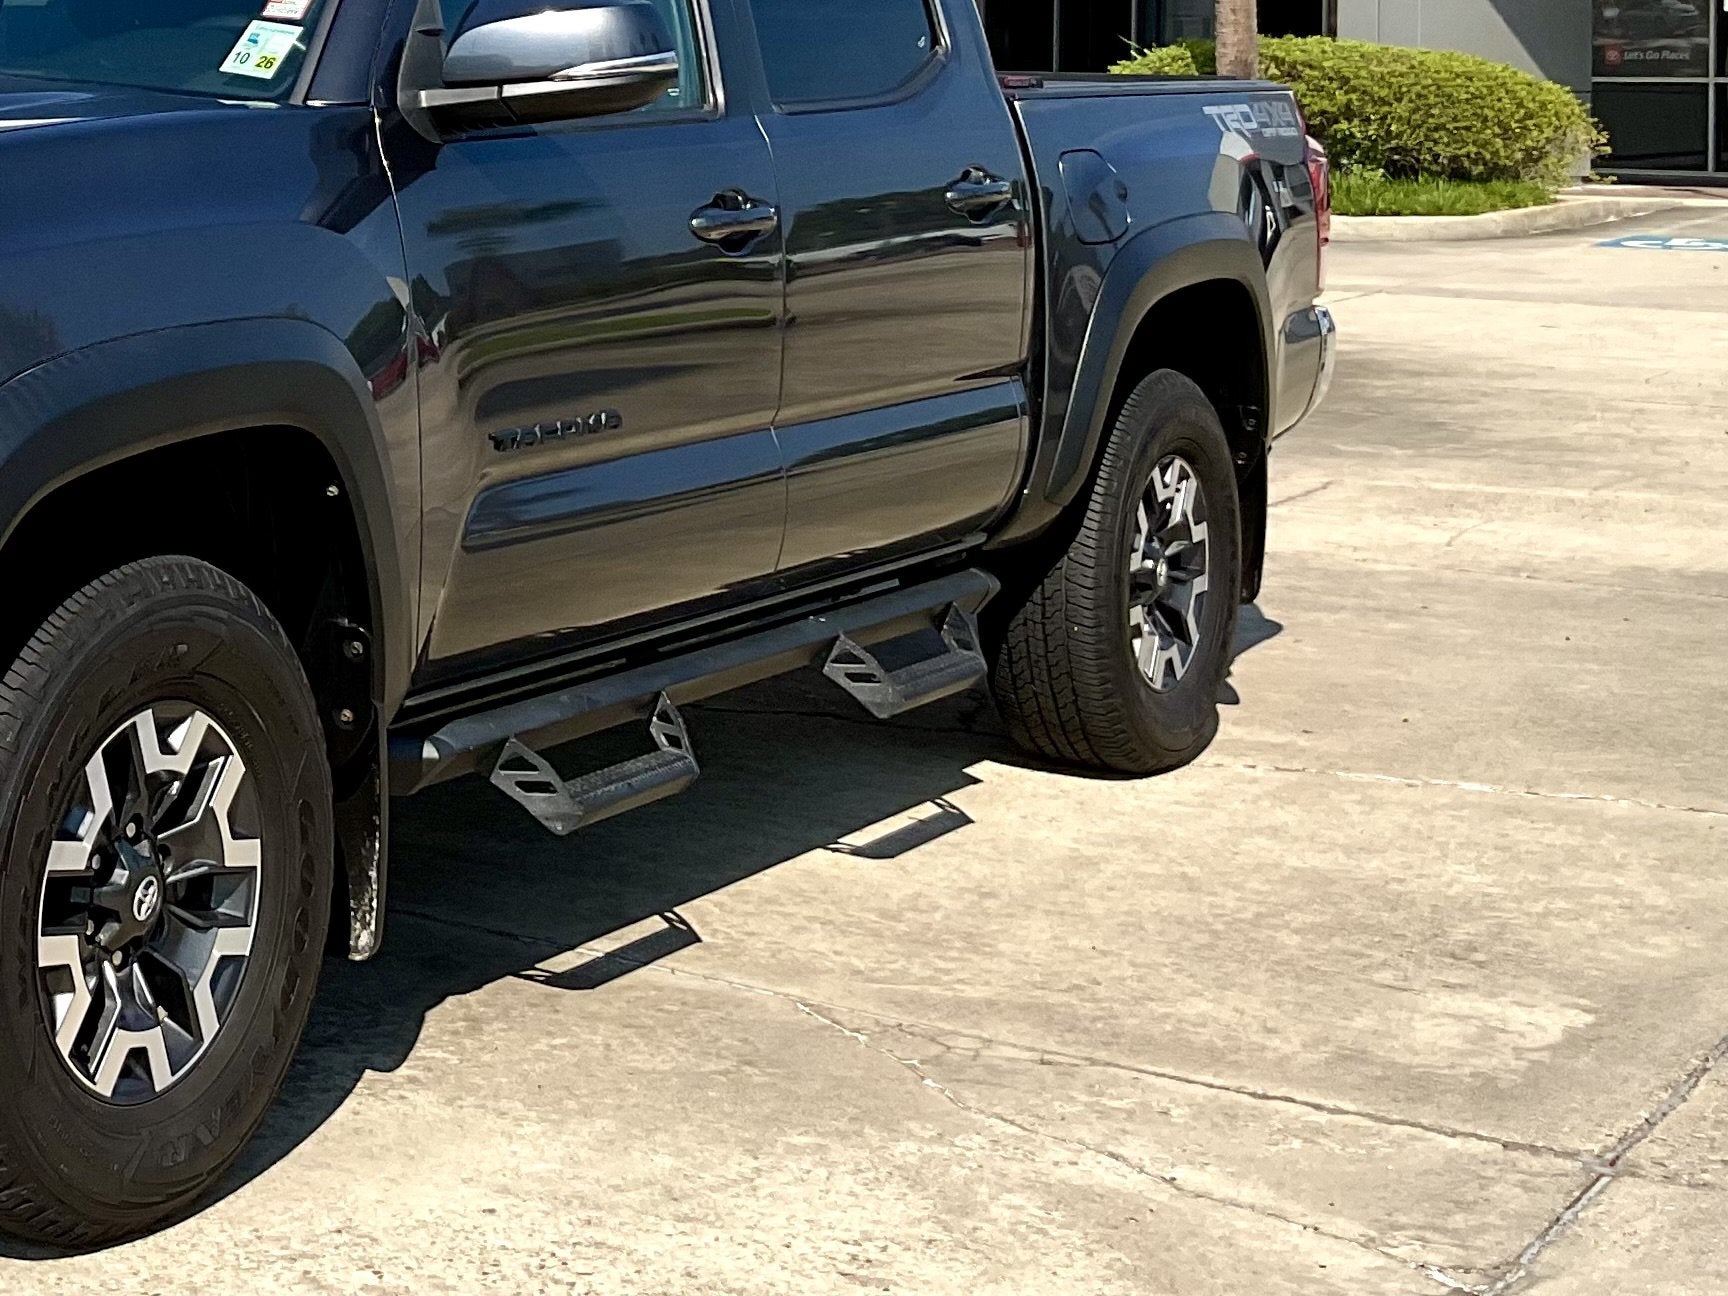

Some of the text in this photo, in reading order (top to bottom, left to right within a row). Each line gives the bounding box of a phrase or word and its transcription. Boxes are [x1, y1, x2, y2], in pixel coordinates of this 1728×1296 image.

[233, 51, 276, 70] 10 26
[1202, 104, 1258, 137] TRD
